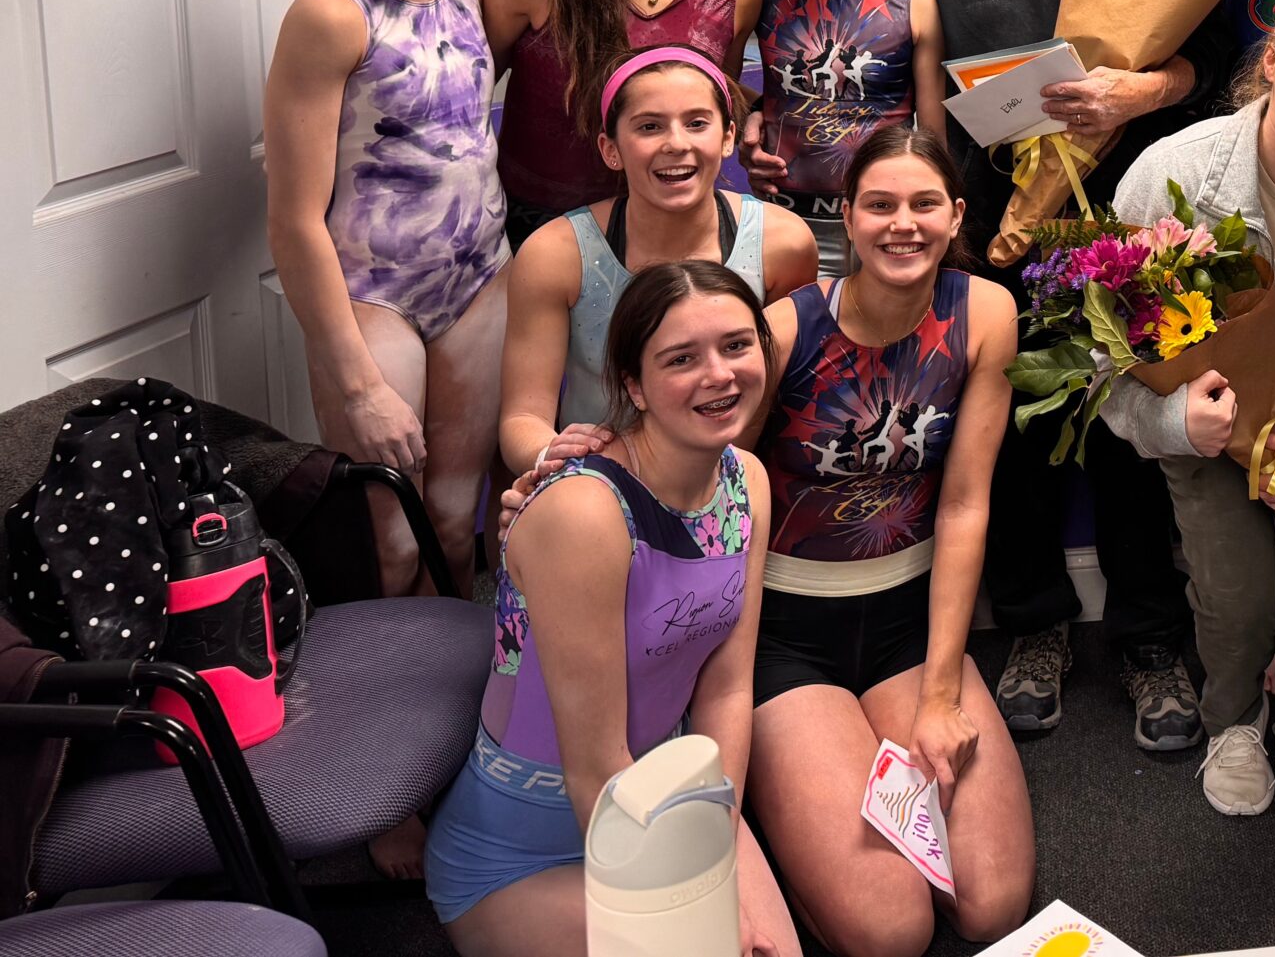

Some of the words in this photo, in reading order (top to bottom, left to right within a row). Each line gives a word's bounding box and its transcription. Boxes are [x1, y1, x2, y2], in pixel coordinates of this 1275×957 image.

[785, 94, 873, 120] Liberty
[1000, 98, 1022, 114] EARL
[812, 197, 848, 214] NI
[475, 738, 522, 782] KE
